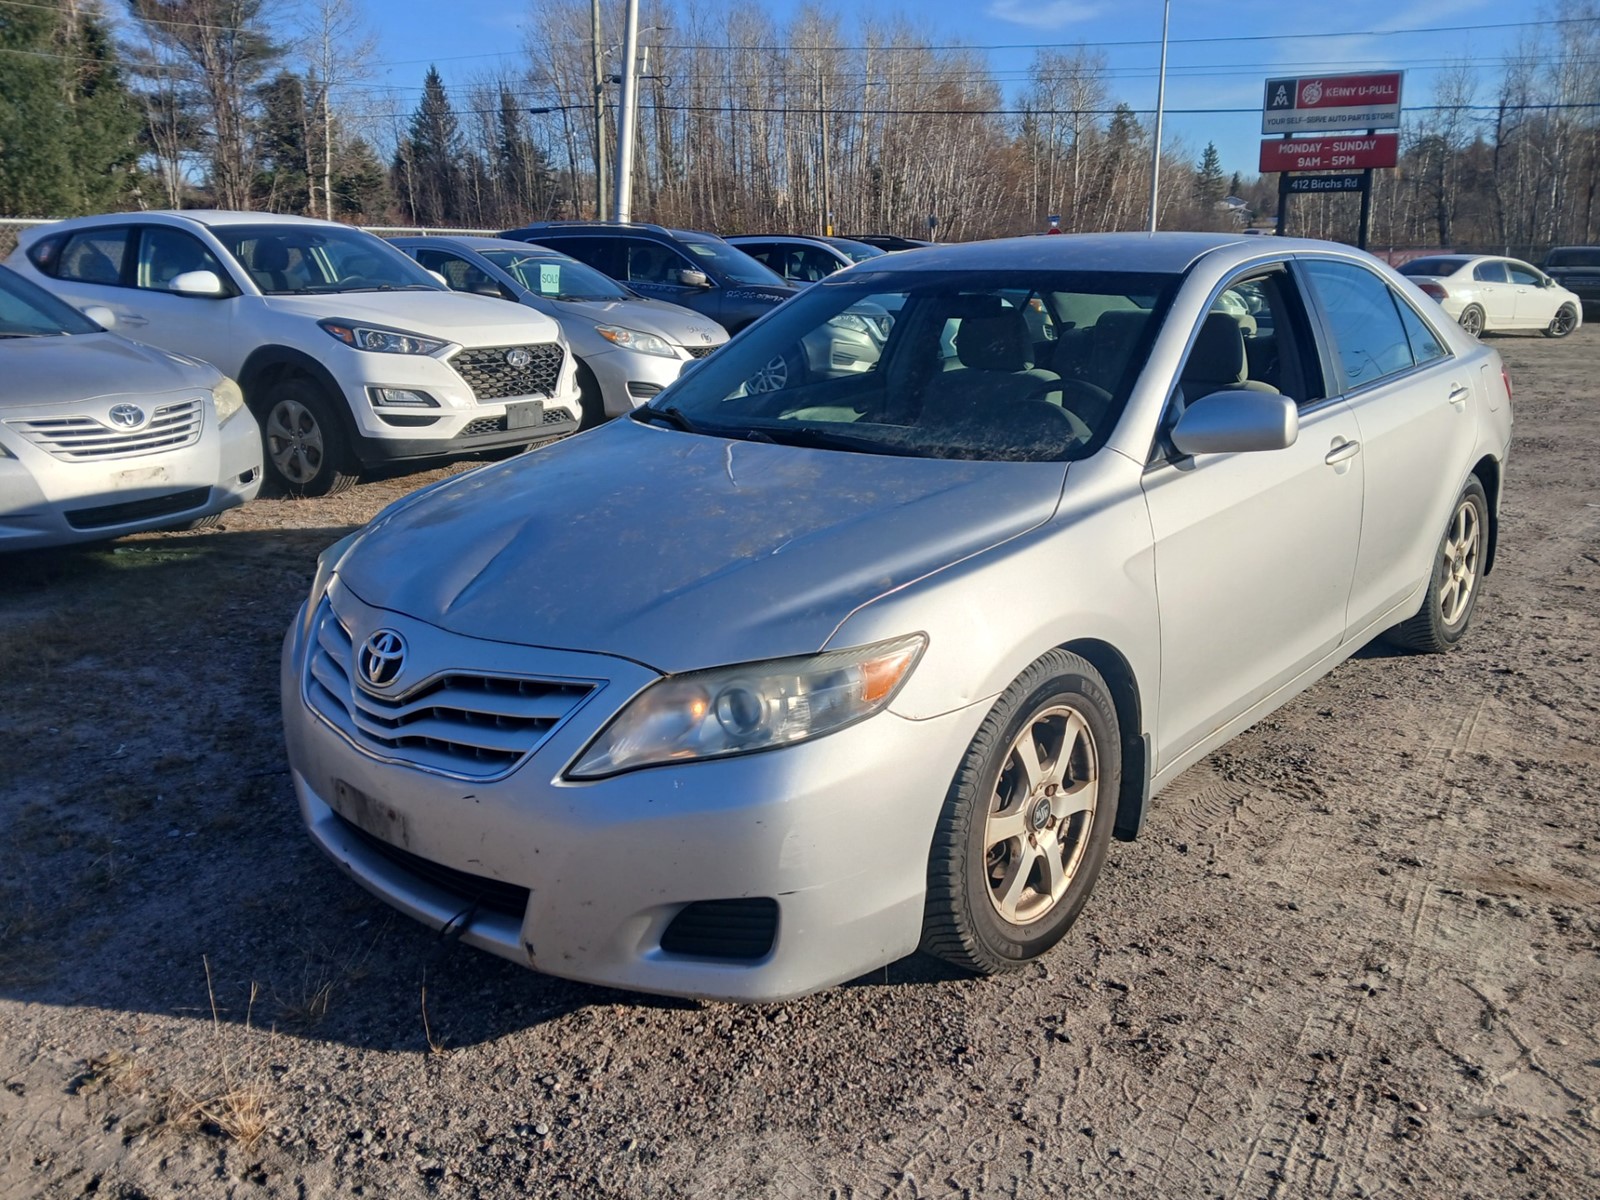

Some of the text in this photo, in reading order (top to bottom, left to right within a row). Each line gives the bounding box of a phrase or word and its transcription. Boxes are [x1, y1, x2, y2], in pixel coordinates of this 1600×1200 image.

[1326, 85, 1394, 97] KENNY U-PULL
[1267, 112, 1395, 126] YOUR SELF-SERVE AUTO PARTS STORE
[1278, 143, 1322, 154] MONDAY
[1332, 140, 1377, 152] SUNDAY
[1297, 157, 1321, 167] 9AM
[1331, 155, 1356, 166] 5PM
[1291, 178, 1358, 189] 412 Birchs Rd
